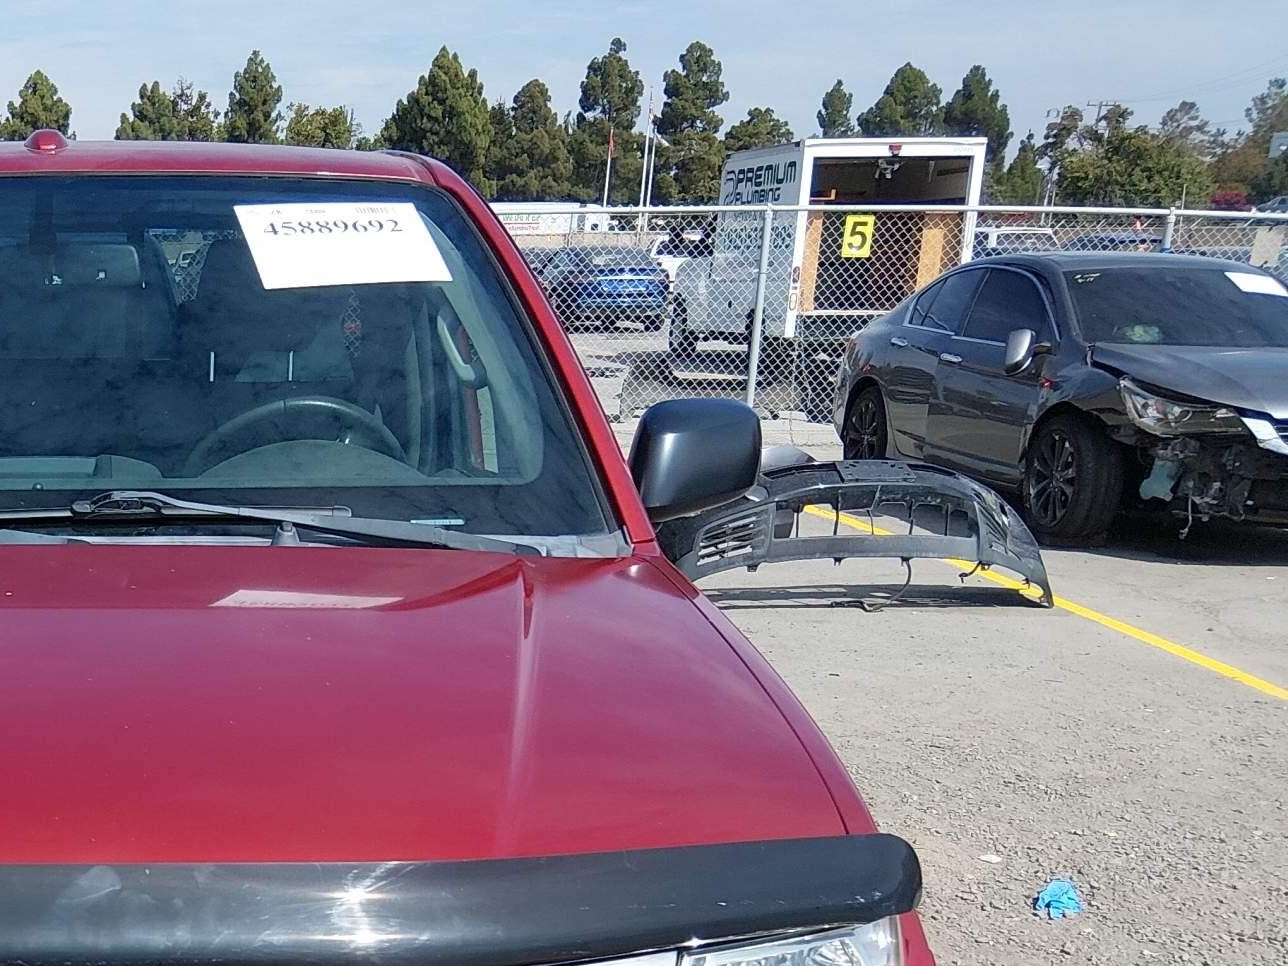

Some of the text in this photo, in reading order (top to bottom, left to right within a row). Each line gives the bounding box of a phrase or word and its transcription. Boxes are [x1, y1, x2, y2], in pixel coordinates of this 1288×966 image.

[735, 161, 797, 190] PREMIUM
[735, 187, 781, 205] PLUMBING
[263, 219, 404, 236] 45889692
[847, 221, 869, 251] 5
